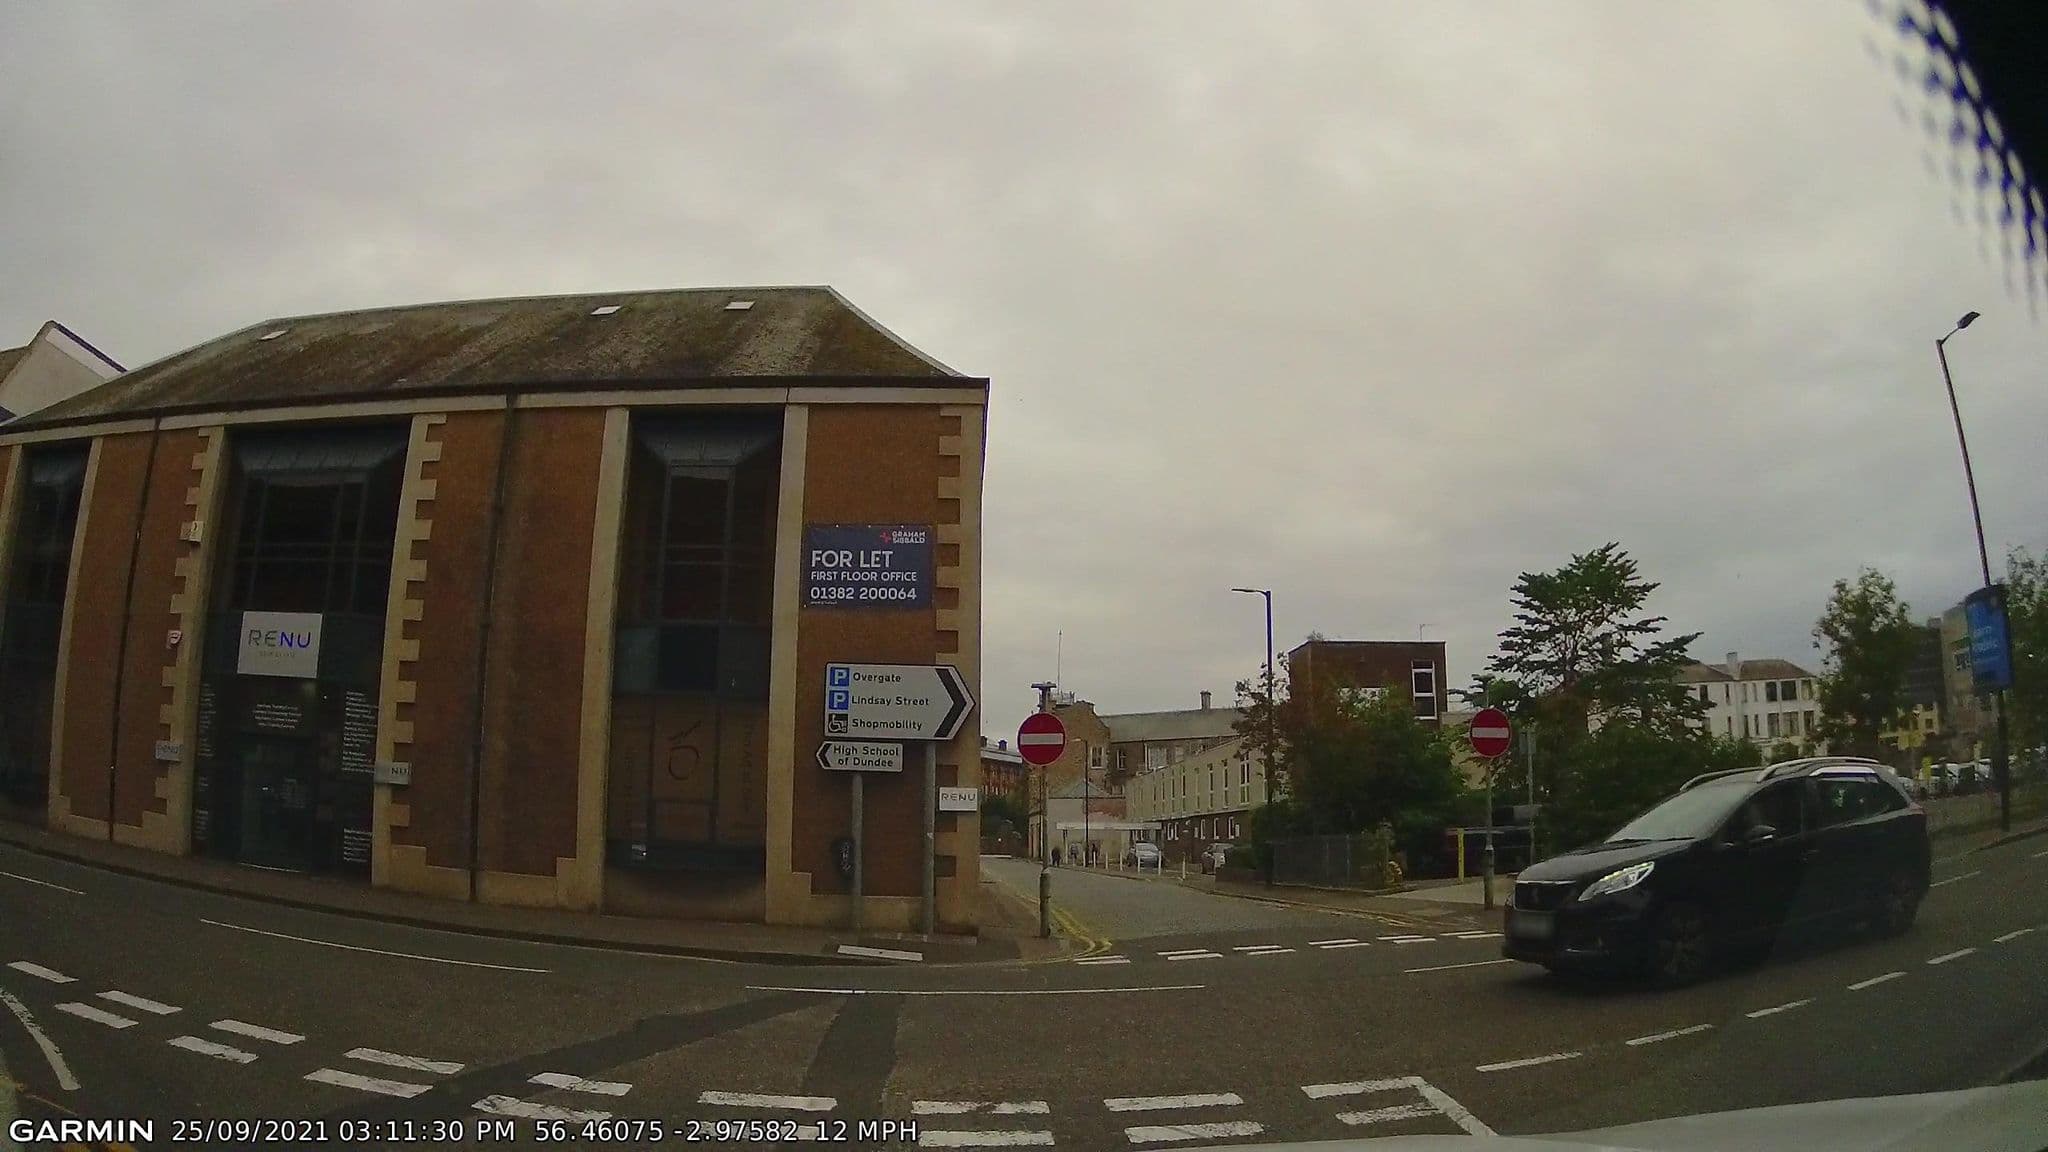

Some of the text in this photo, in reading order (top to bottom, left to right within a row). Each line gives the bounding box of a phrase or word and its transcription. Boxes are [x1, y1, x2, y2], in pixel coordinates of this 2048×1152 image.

[811, 550, 893, 568] FOR LET
[811, 571, 918, 582] FIRST FLOOR OFFICE
[810, 587, 917, 600] 01382 200064
[248, 629, 312, 649] RENU
[853, 672, 902, 683] Overgate
[851, 696, 892, 706] Lindsay
[896, 696, 929, 706] Street
[852, 718, 922, 731] Shopmobility
[833, 745, 899, 756] High School
[838, 757, 894, 767] of Dundee
[941, 792, 976, 801] RENU
